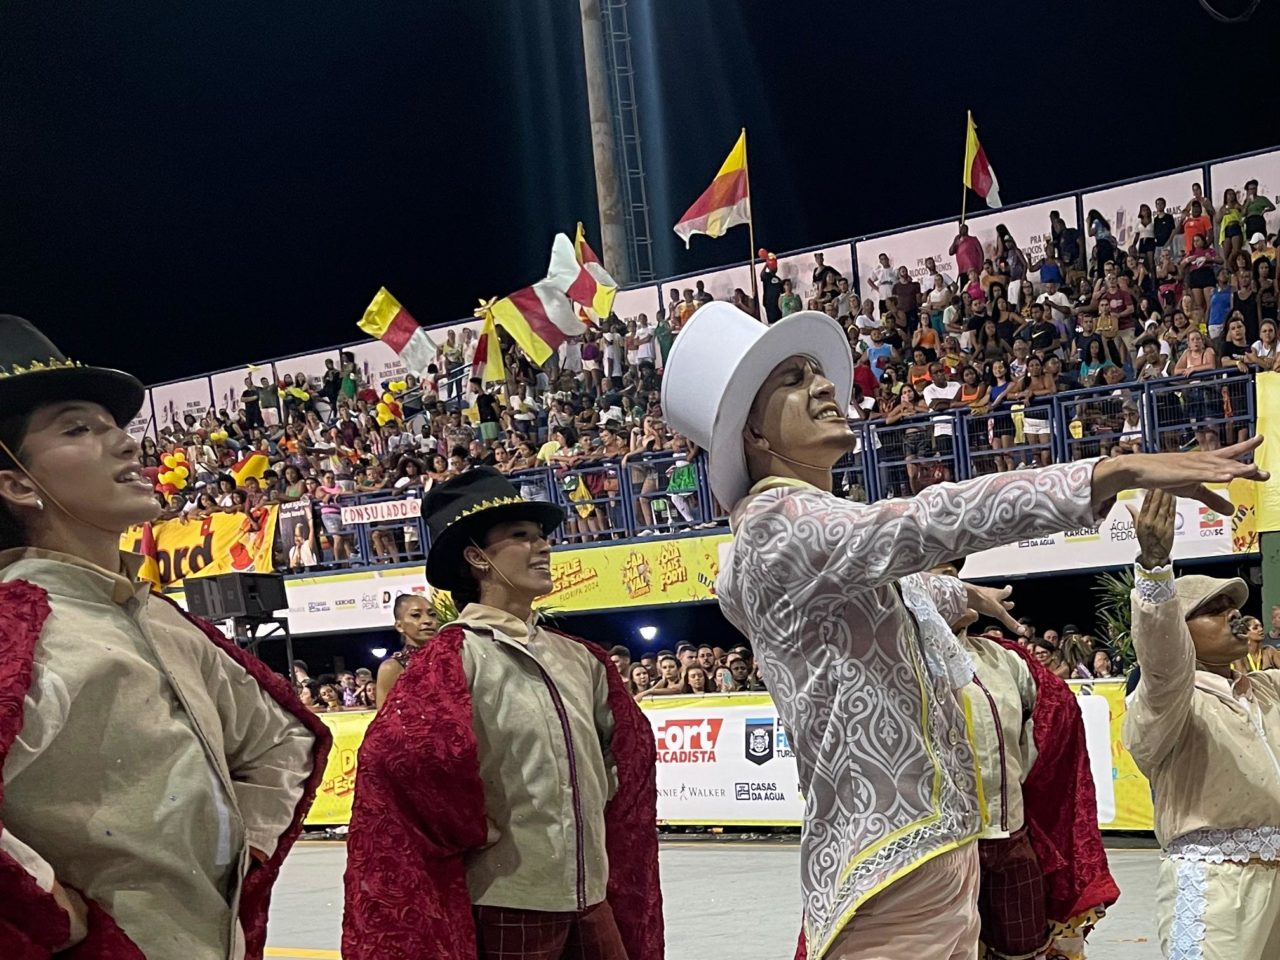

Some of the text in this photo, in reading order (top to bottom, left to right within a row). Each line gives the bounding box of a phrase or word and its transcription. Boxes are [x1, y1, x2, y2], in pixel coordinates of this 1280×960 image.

[344, 503, 407, 522] CONSULADO
[1110, 519, 1134, 531] ÁGUA
[751, 782, 777, 791] CASAS
[688, 787, 726, 797] WALKER
[751, 793, 763, 801] DA
